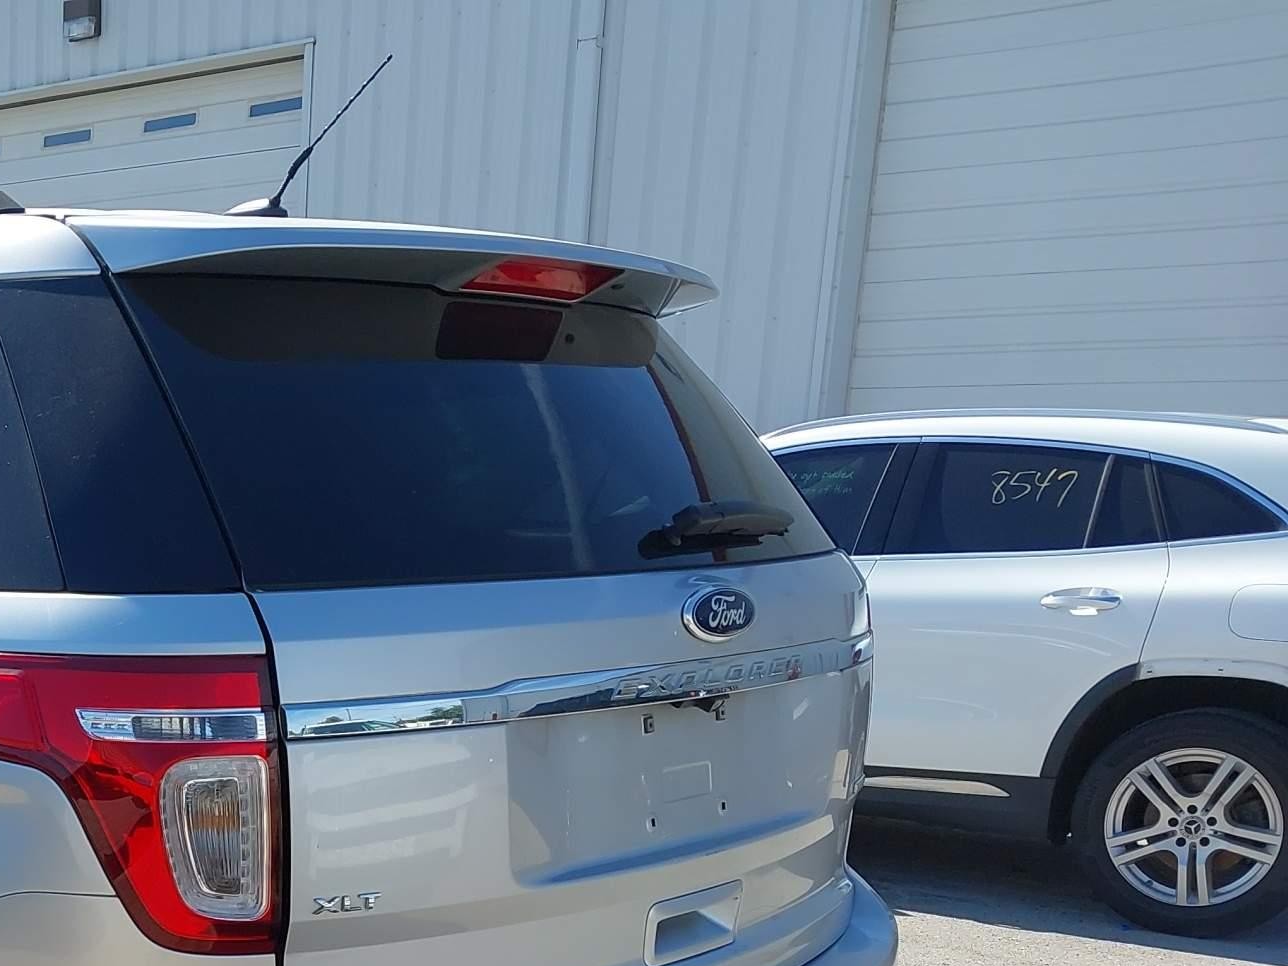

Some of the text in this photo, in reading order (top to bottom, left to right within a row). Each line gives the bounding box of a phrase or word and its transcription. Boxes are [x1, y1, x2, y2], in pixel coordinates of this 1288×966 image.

[708, 594, 747, 628] Ford
[610, 654, 802, 701] EXPLORER
[311, 890, 384, 916] XLT
